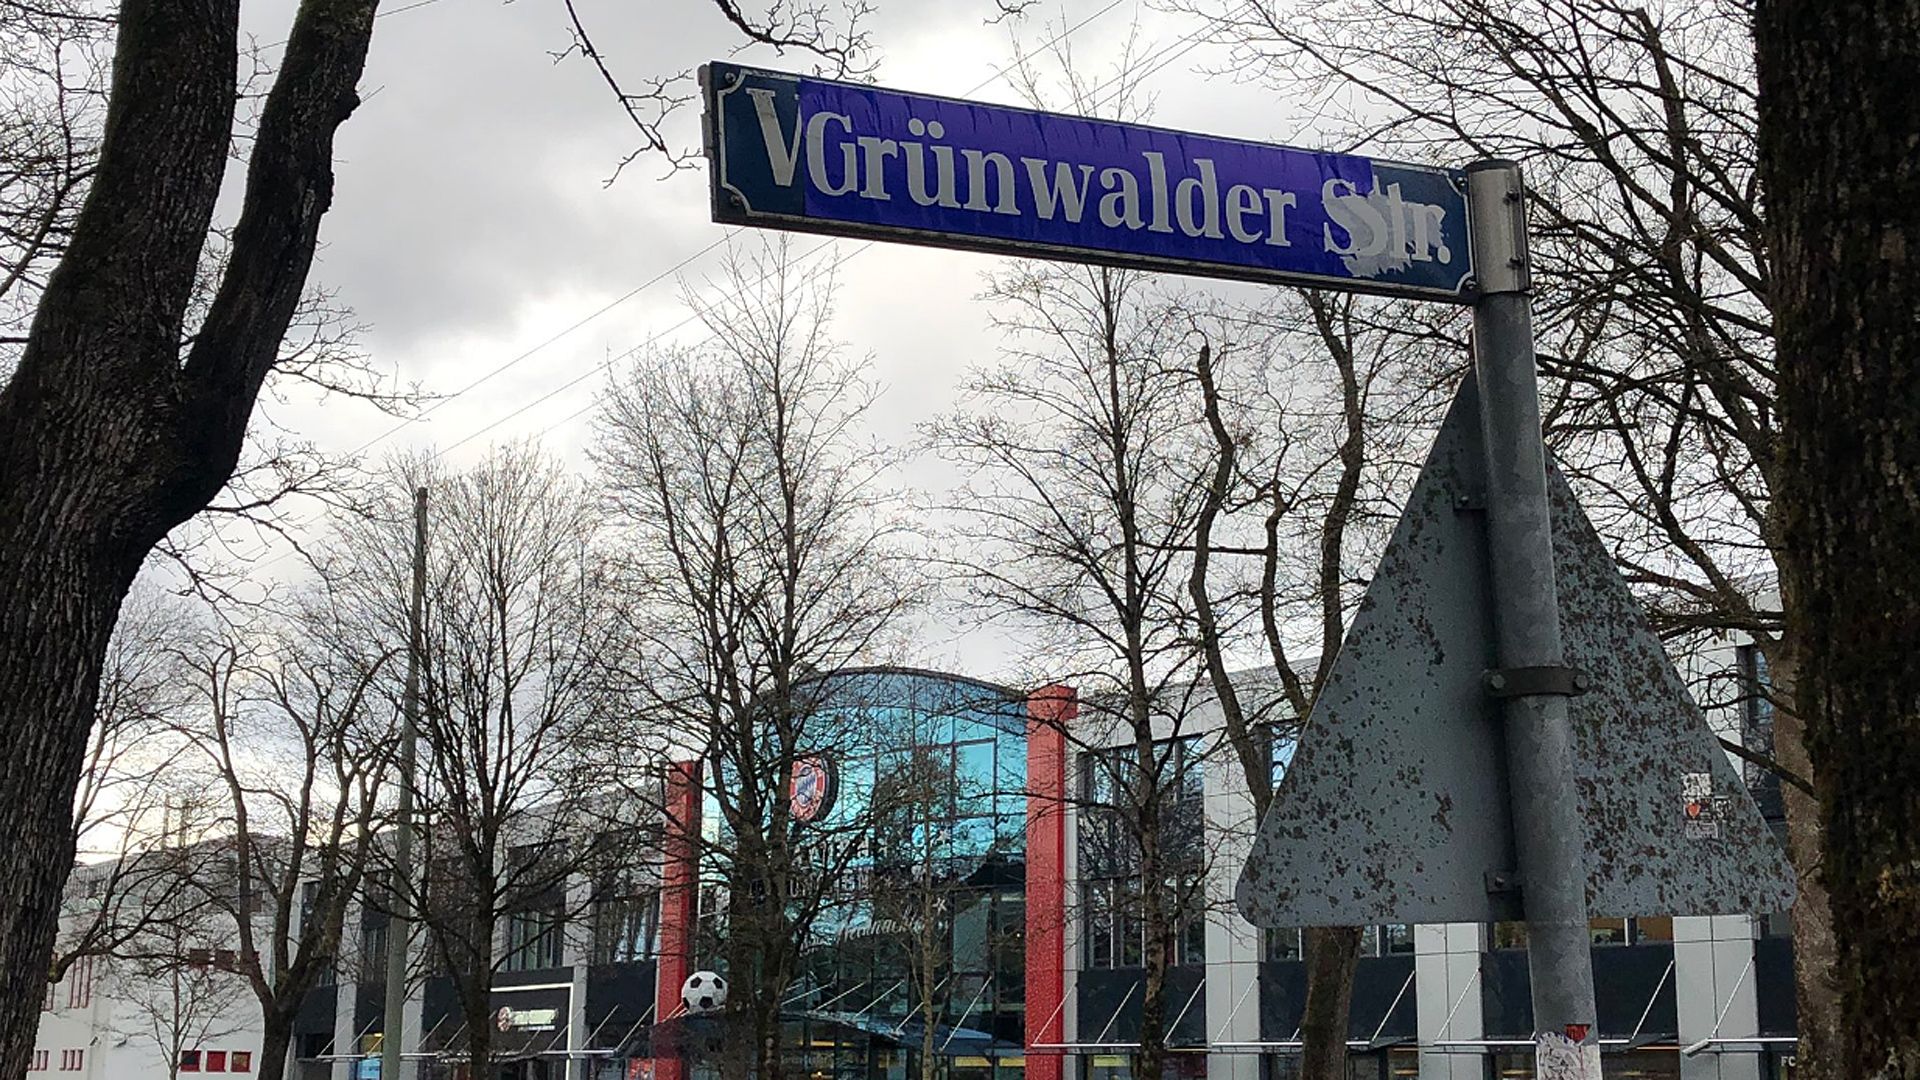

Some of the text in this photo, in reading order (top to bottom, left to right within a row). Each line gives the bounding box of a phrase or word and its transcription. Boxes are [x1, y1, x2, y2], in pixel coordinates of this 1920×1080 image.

[806, 111, 1297, 247] Grünwalder
[1321, 176, 1450, 264] Str.
[1781, 1056, 1797, 1067] FC
